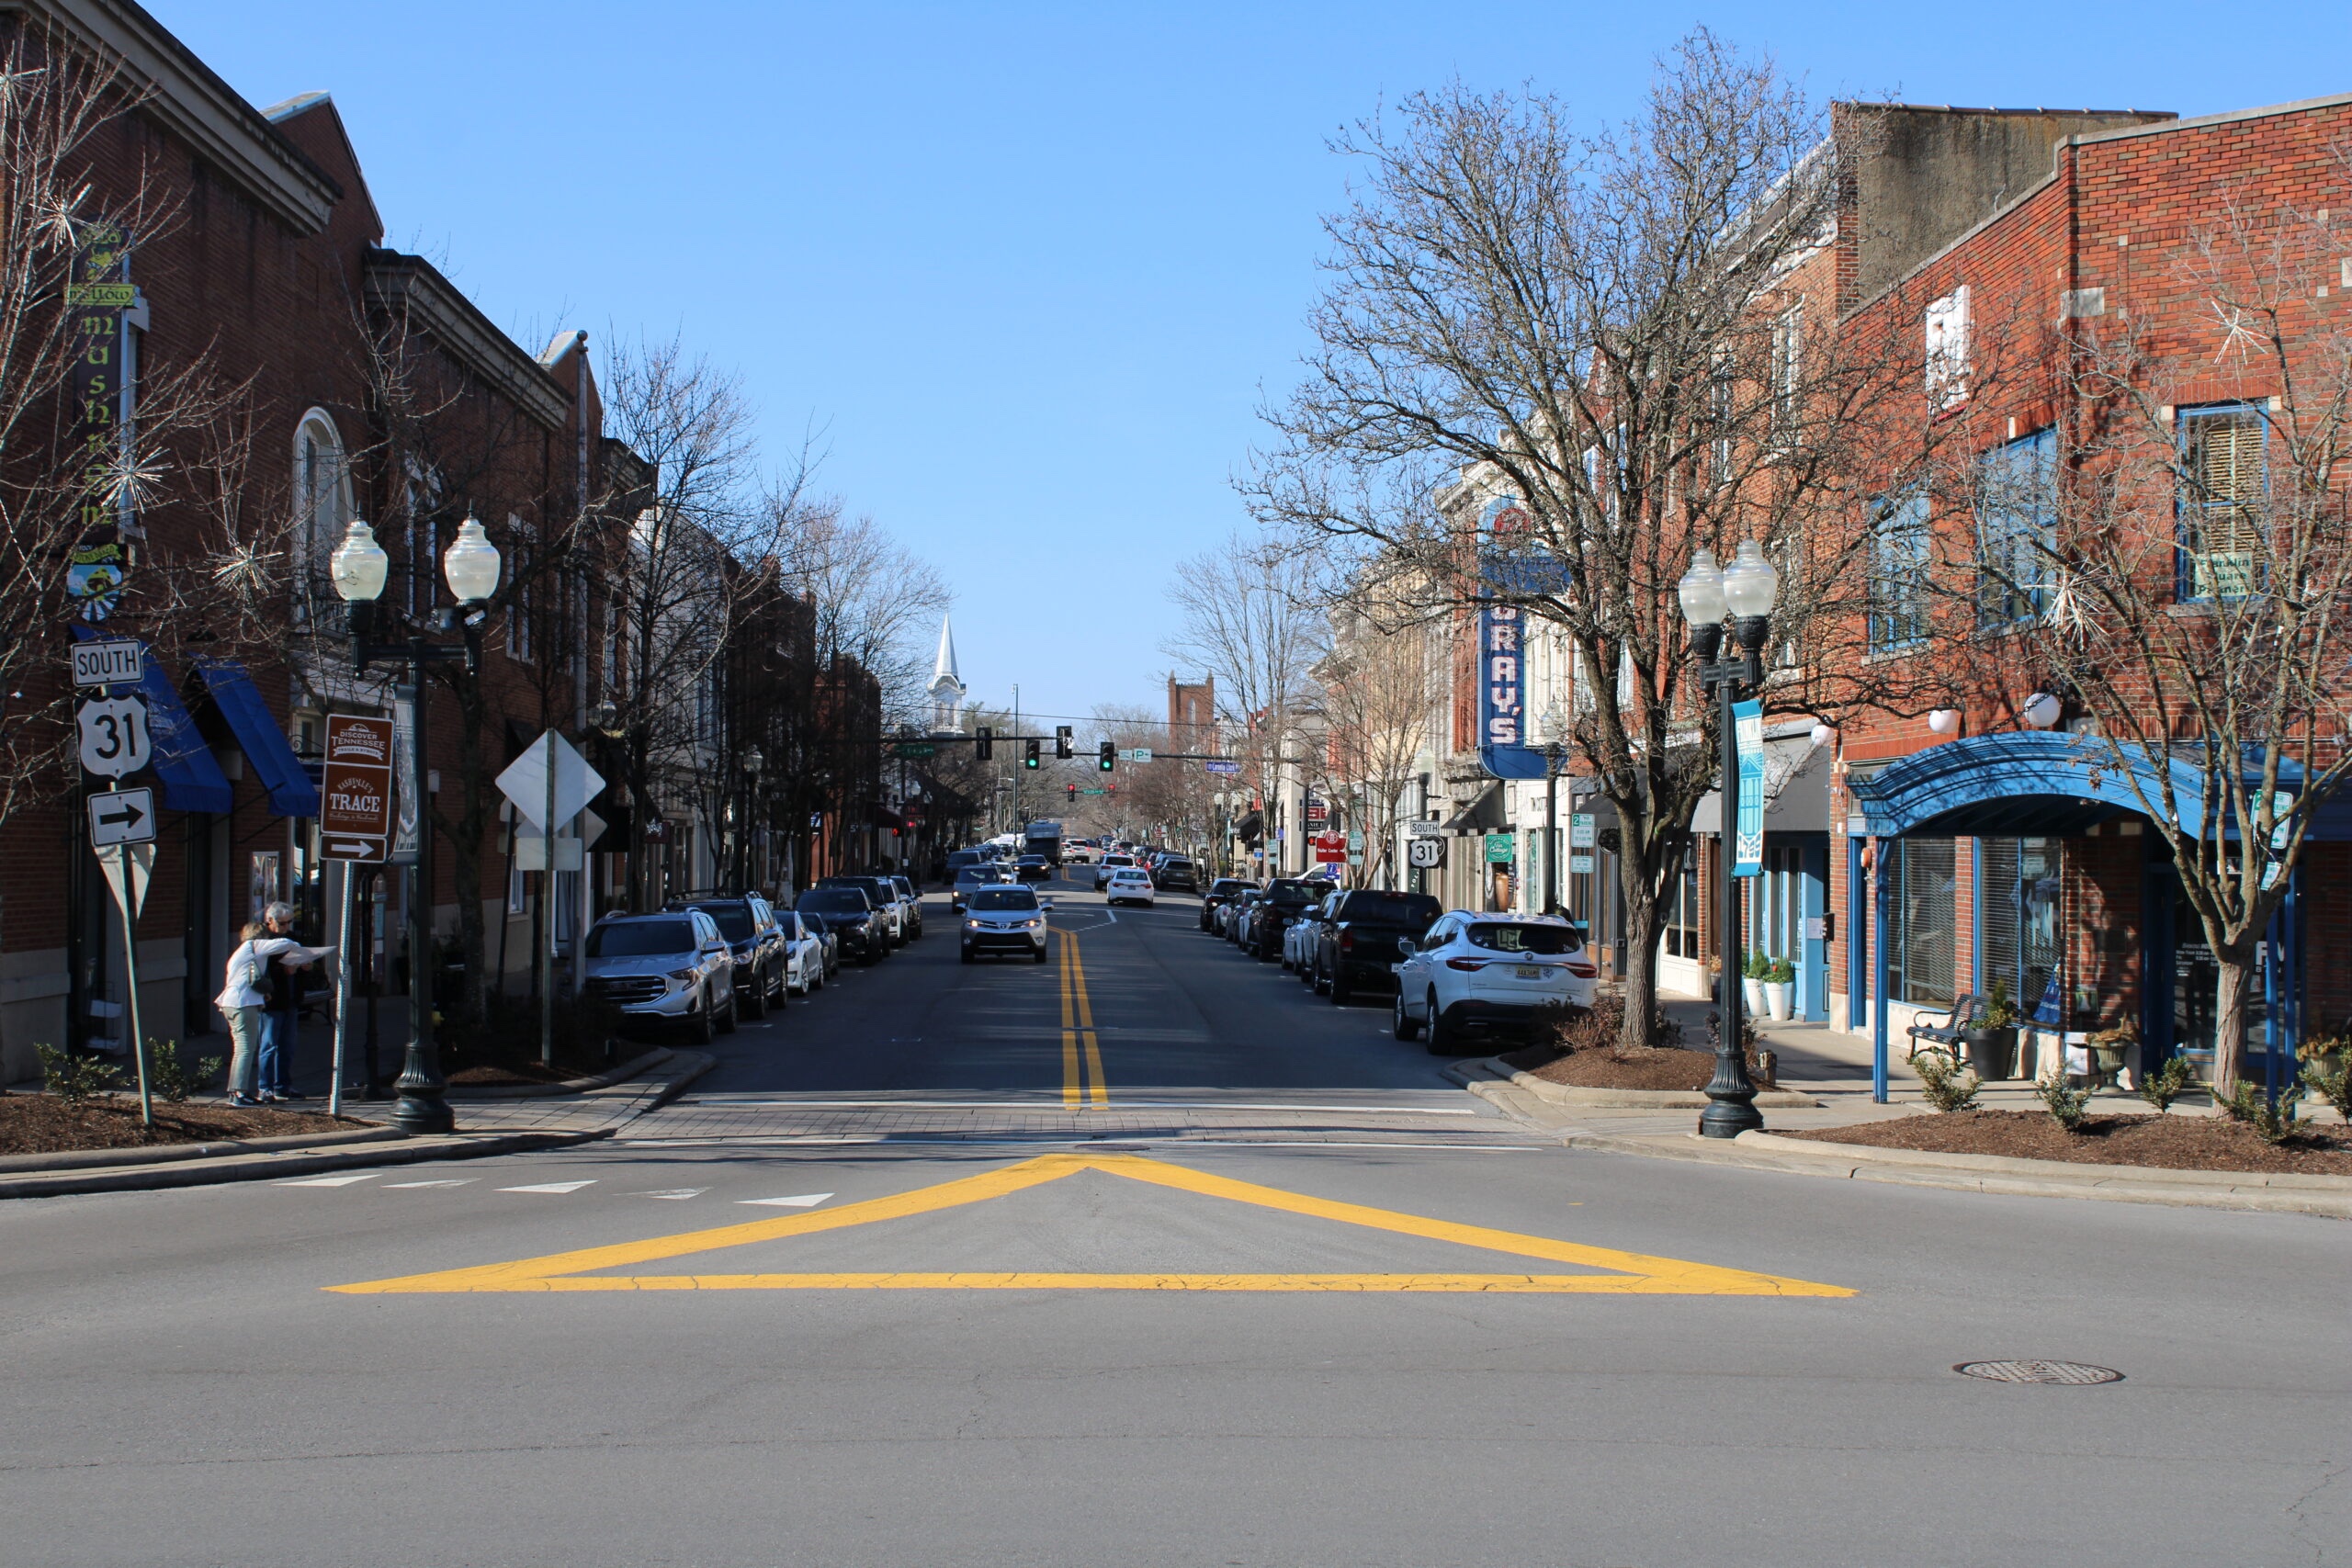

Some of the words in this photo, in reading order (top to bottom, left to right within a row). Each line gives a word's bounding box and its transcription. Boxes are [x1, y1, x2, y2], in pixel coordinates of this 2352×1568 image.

[77, 649, 137, 676] SOUTH
[95, 712, 136, 760] 31
[339, 731, 378, 739] DISCOVER
[331, 736, 386, 750] TENNESSEE
[1136, 750, 1145, 760] P
[329, 793, 380, 813] TRACE
[1411, 823, 1438, 832] SOUTH
[1573, 816, 1579, 825] 2
[1416, 845, 1432, 861] 31
[1738, 832, 1761, 859] 1799
